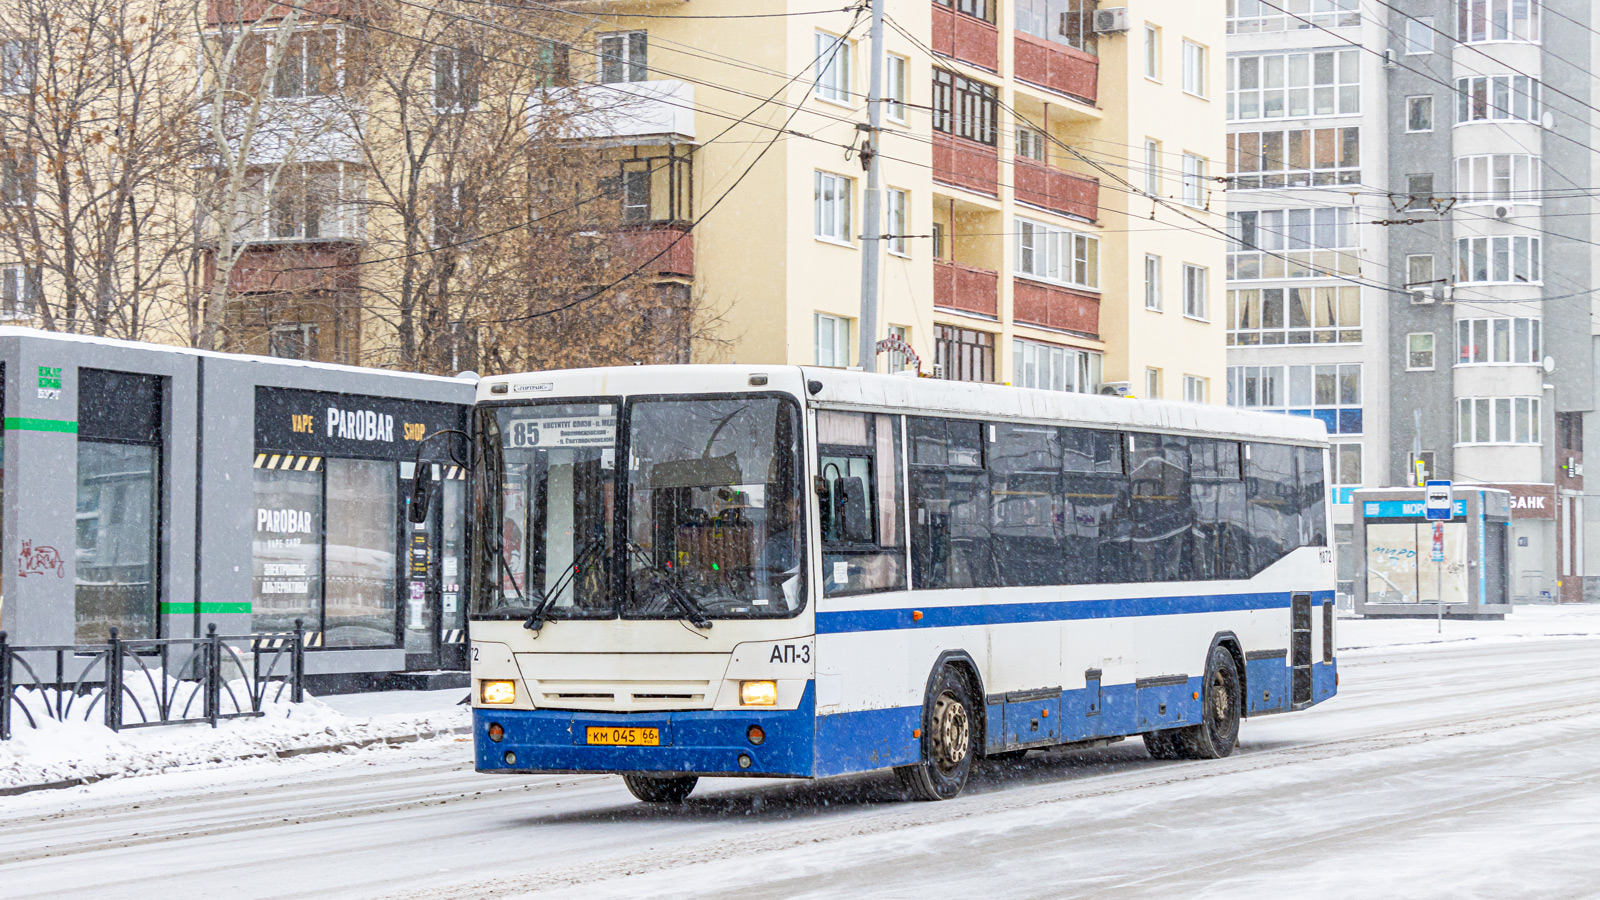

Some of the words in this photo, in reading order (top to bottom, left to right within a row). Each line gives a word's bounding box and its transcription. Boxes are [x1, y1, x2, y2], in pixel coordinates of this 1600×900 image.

[291, 414, 314, 434] VAPE
[403, 422, 426, 441] SHOP
[513, 422, 540, 446] 85
[263, 563, 307, 576] ЭЛЕКТРОННЫЕ
[261, 581, 309, 594] АЛЬТЕРНАТИВЫ
[769, 644, 810, 664] АП-3
[593, 732, 608, 742] КМ
[612, 729, 636, 743] 045
[642, 729, 655, 740] 66
